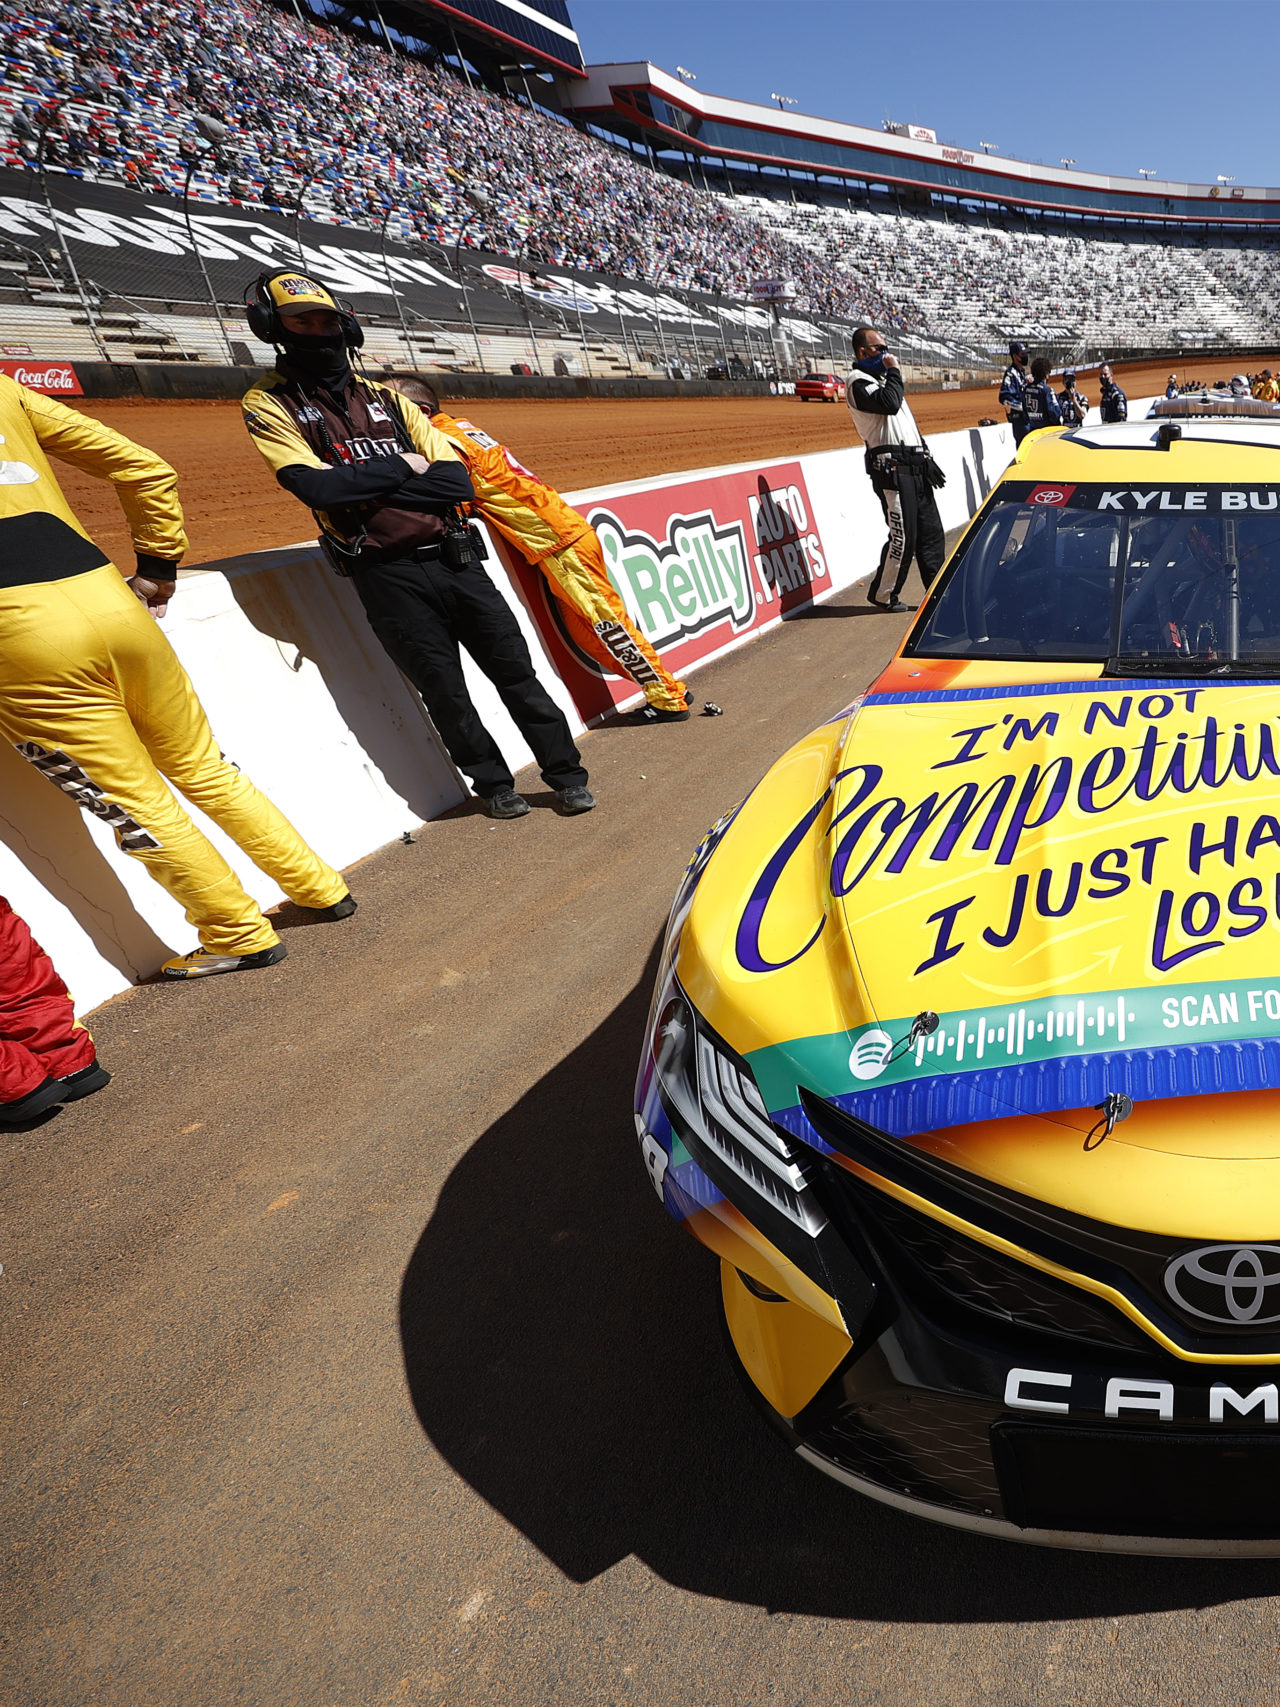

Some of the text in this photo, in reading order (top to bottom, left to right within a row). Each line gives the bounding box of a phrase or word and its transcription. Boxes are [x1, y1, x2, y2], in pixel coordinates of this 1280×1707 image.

[14, 367, 74, 389] Coca-Cola
[747, 484, 808, 548] AUTO
[1097, 490, 1209, 511] KYLE
[889, 511, 904, 561] OFFICIAL
[605, 532, 745, 633] 'Reilly
[752, 533, 827, 604] PARTS
[931, 689, 1208, 770] I'M NOT
[914, 895, 976, 976] I
[983, 836, 1169, 948] JUST
[1162, 991, 1240, 1029] SCAN
